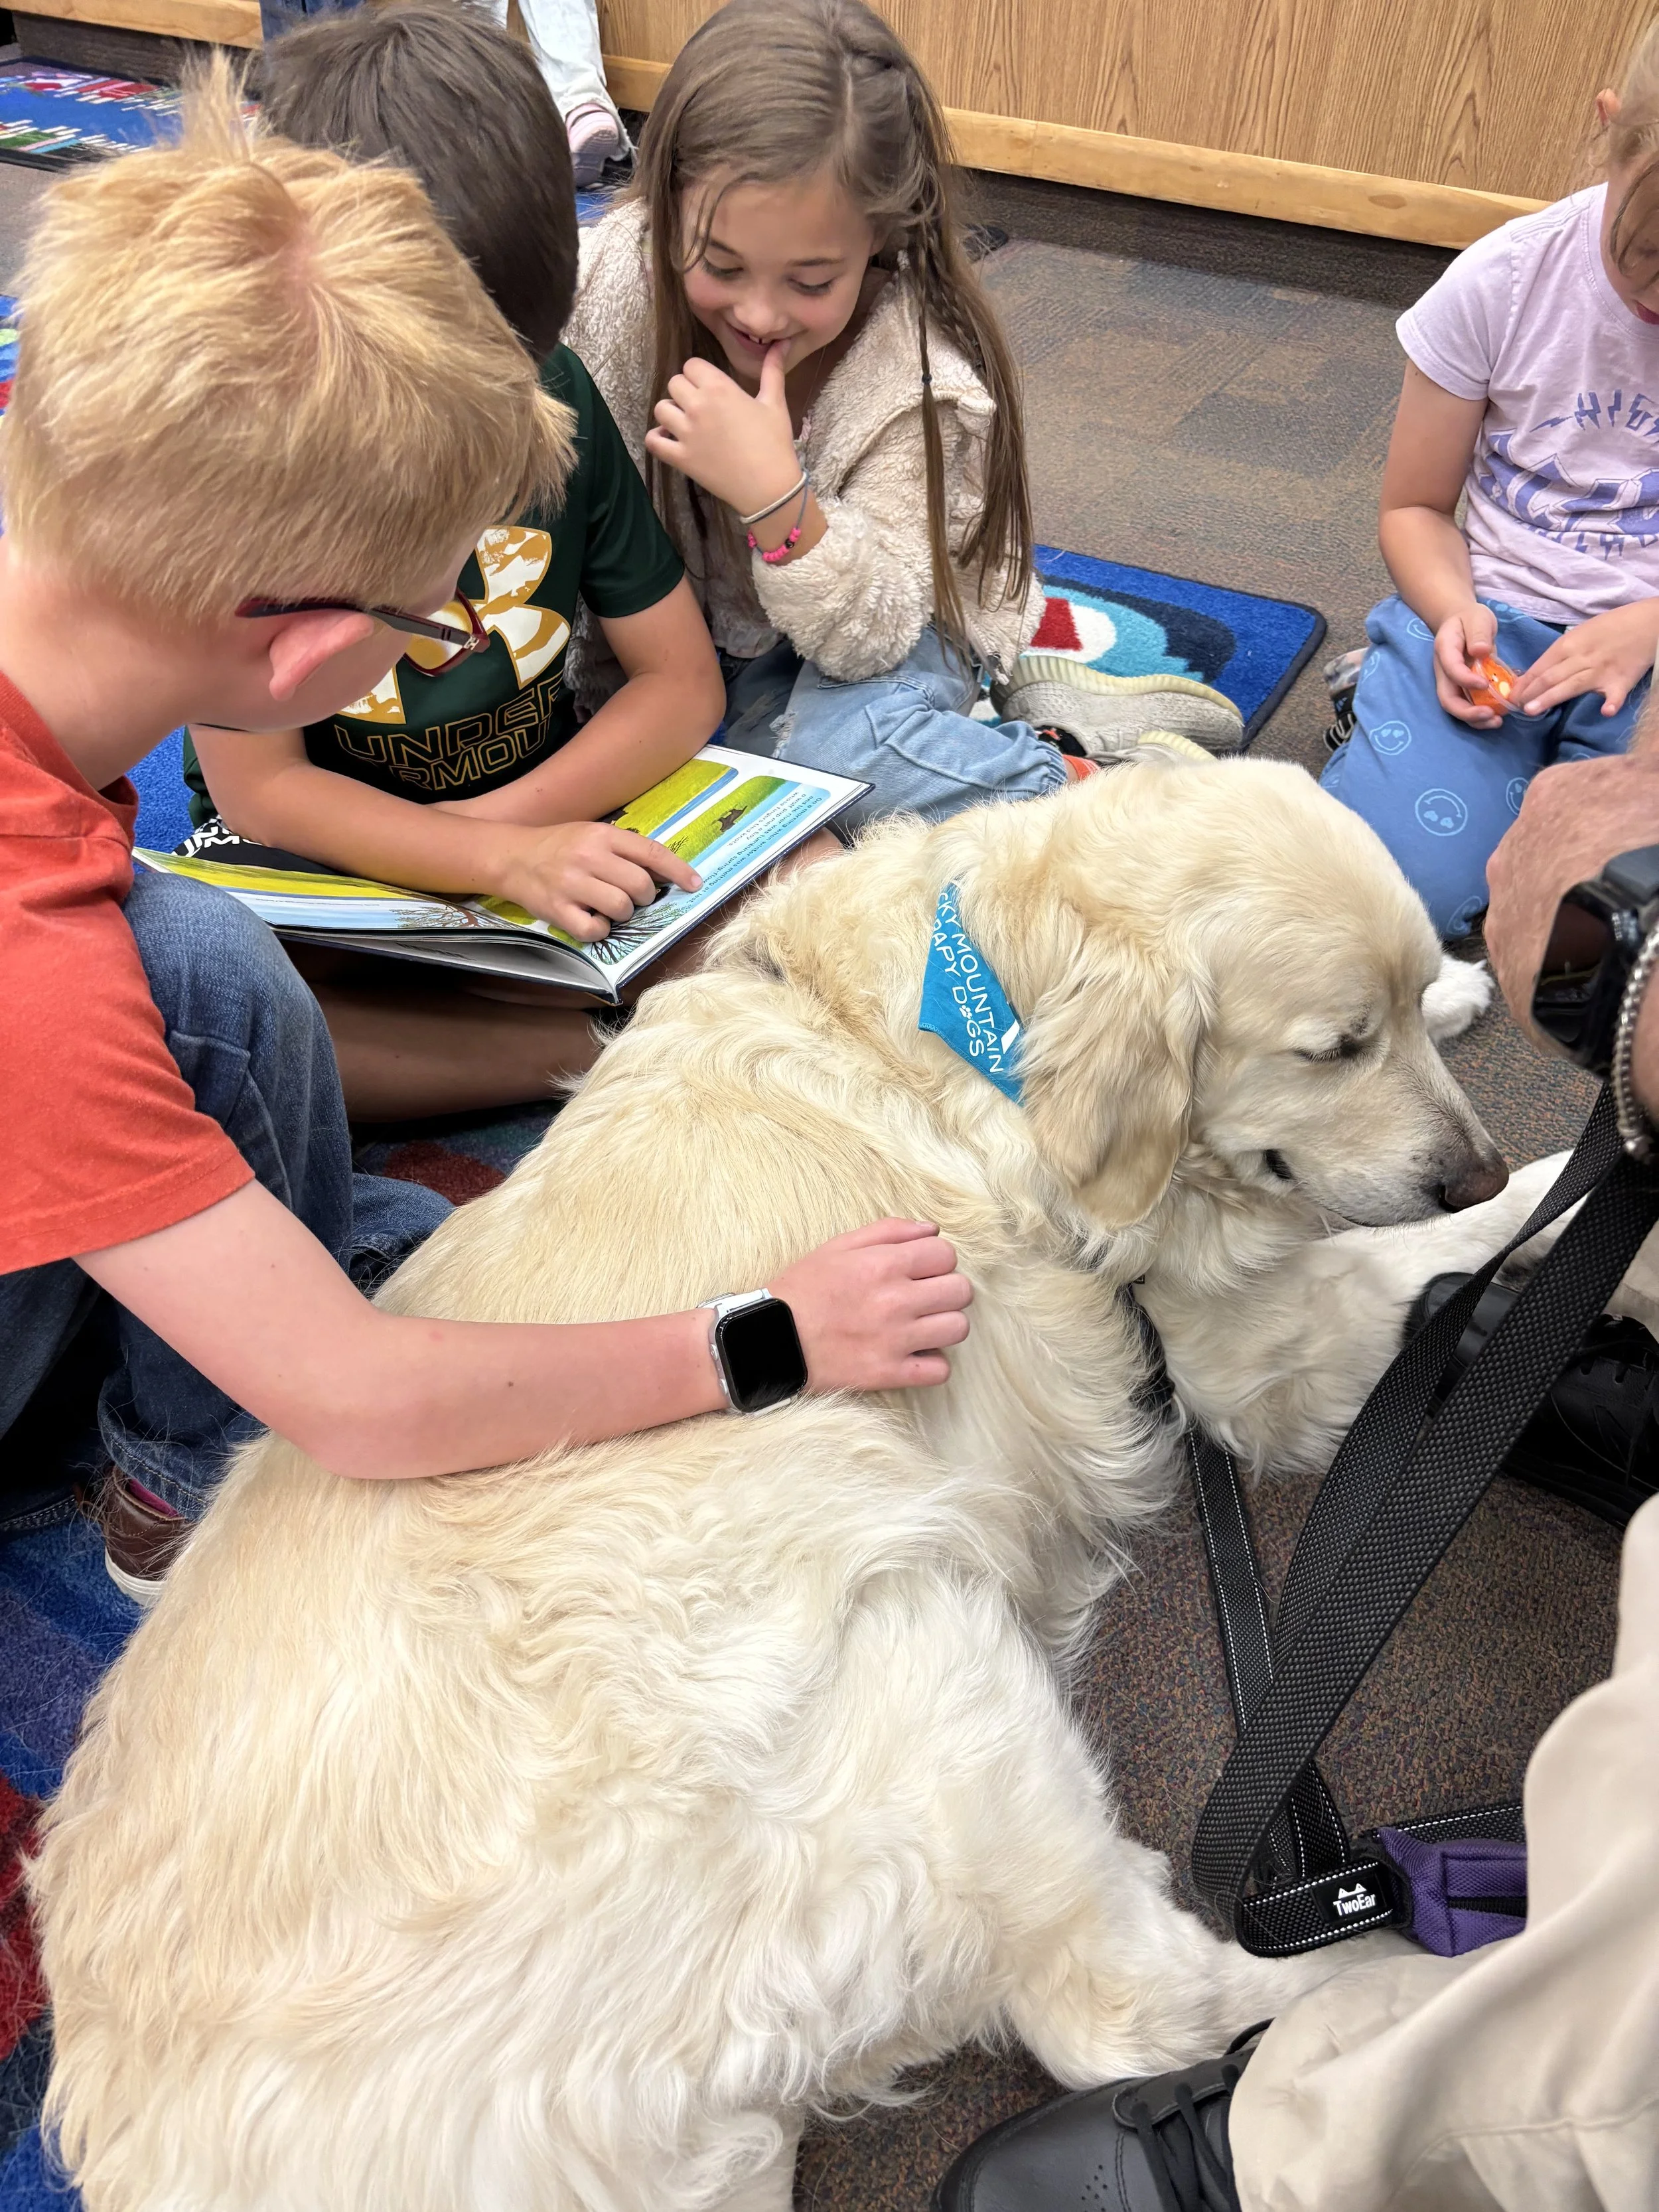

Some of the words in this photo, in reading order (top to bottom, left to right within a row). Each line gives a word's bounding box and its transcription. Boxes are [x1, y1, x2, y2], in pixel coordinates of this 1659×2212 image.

[389, 718, 552, 790] RMOU
[780, 792, 798, 806] whose
[788, 798, 801, 808] wolf
[802, 796, 814, 805] and
[758, 806, 780, 822] fingers
[775, 808, 788, 818] pup
[778, 813, 792, 824] river
[782, 808, 808, 828] morning
[746, 824, 759, 833] tied
[764, 818, 776, 827] met
[764, 824, 777, 834] was
[746, 832, 758, 840] boy
[766, 828, 782, 841] when
[737, 835, 765, 855] tumbling
[747, 842, 766, 857] winter
[733, 857, 746, 867] was
[708, 867, 733, 886] melting
[951, 932, 1004, 1073] MOUNTAIN
[1333, 1893, 1376, 1916] TwoEar
